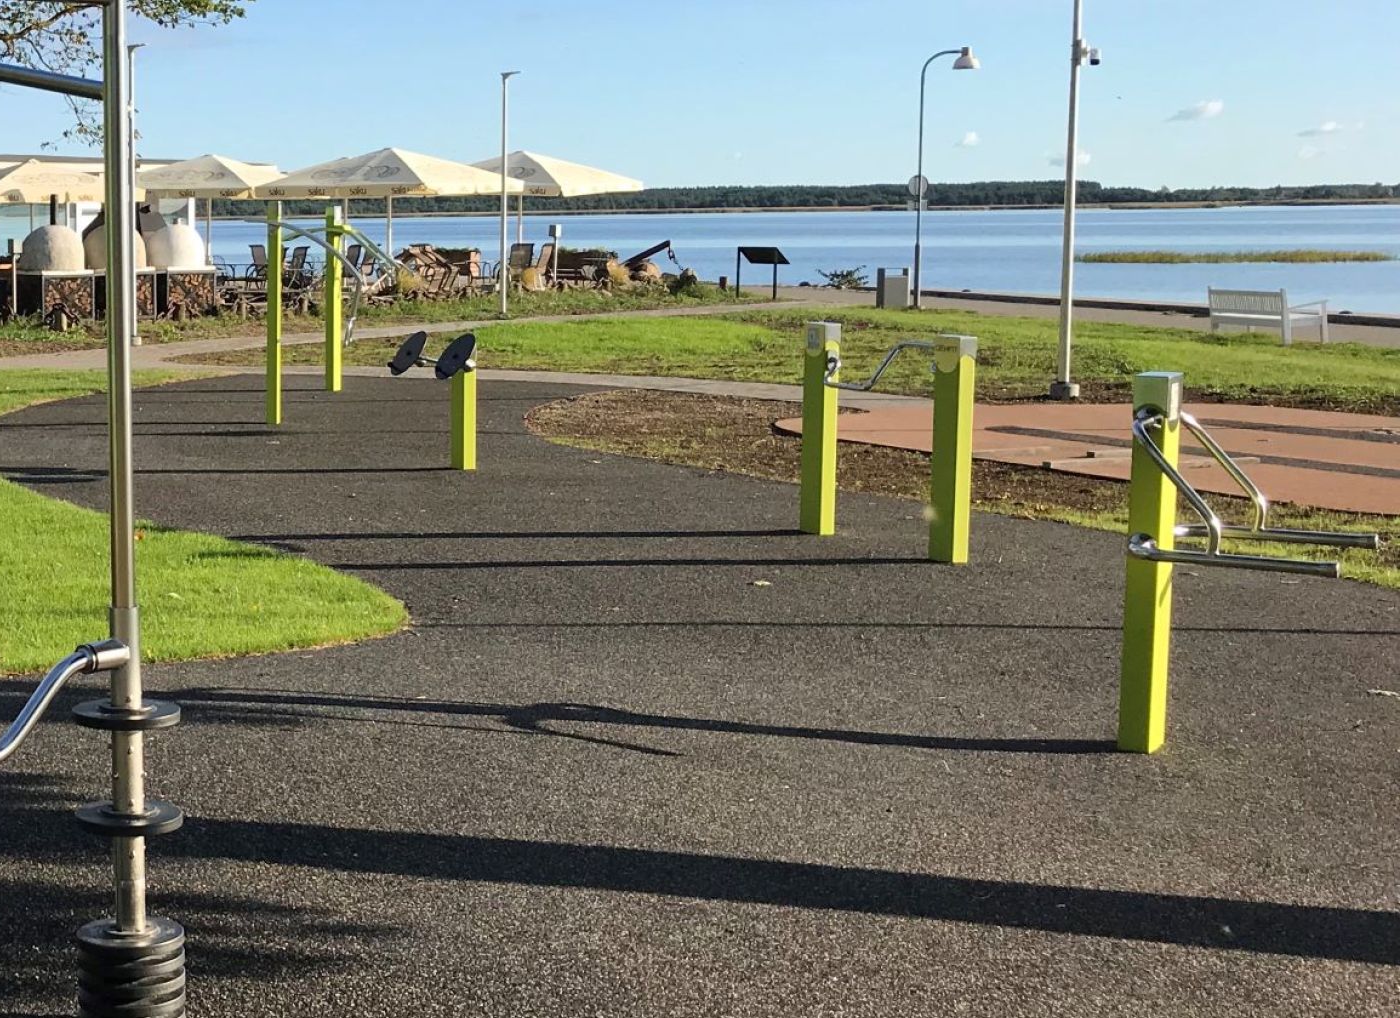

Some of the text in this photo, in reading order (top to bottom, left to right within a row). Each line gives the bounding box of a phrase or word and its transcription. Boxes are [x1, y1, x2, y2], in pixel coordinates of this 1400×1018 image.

[268, 186, 285, 196] saku
[308, 186, 326, 196] saku
[349, 186, 367, 195] saku
